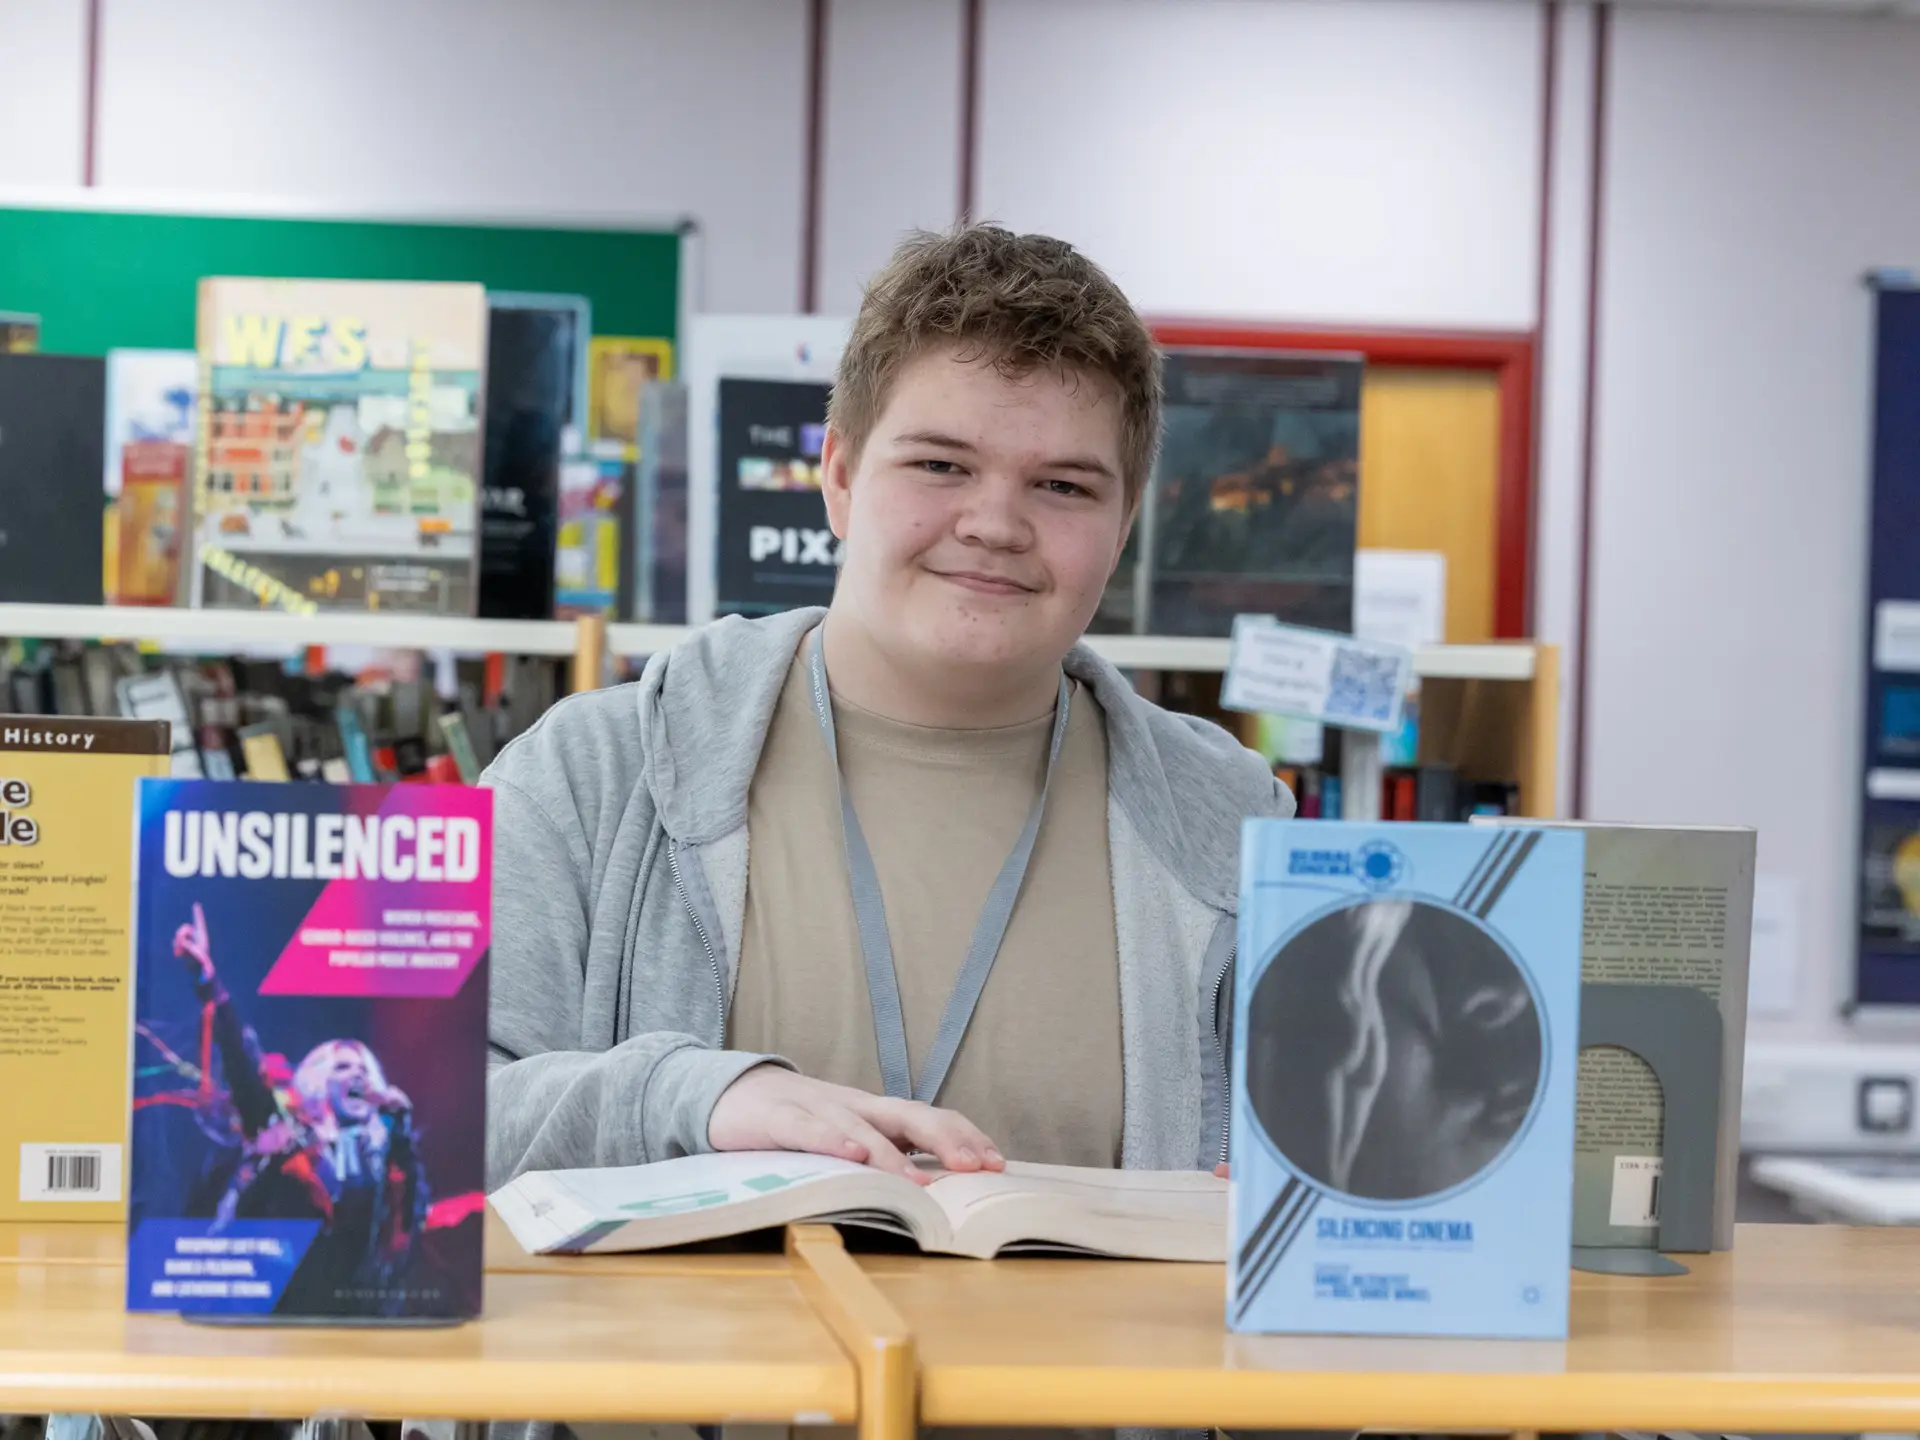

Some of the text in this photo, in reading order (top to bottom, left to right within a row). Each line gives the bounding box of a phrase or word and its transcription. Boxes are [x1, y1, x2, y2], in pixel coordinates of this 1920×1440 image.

[224, 314, 367, 368] WES
[749, 525, 838, 566] PIX
[4, 728, 95, 750] History
[163, 810, 480, 882] UNSILENCED
[51, 874, 69, 884] and
[71, 874, 107, 888] jungles?
[1316, 1216, 1474, 1242] SILENCING CINEMA
